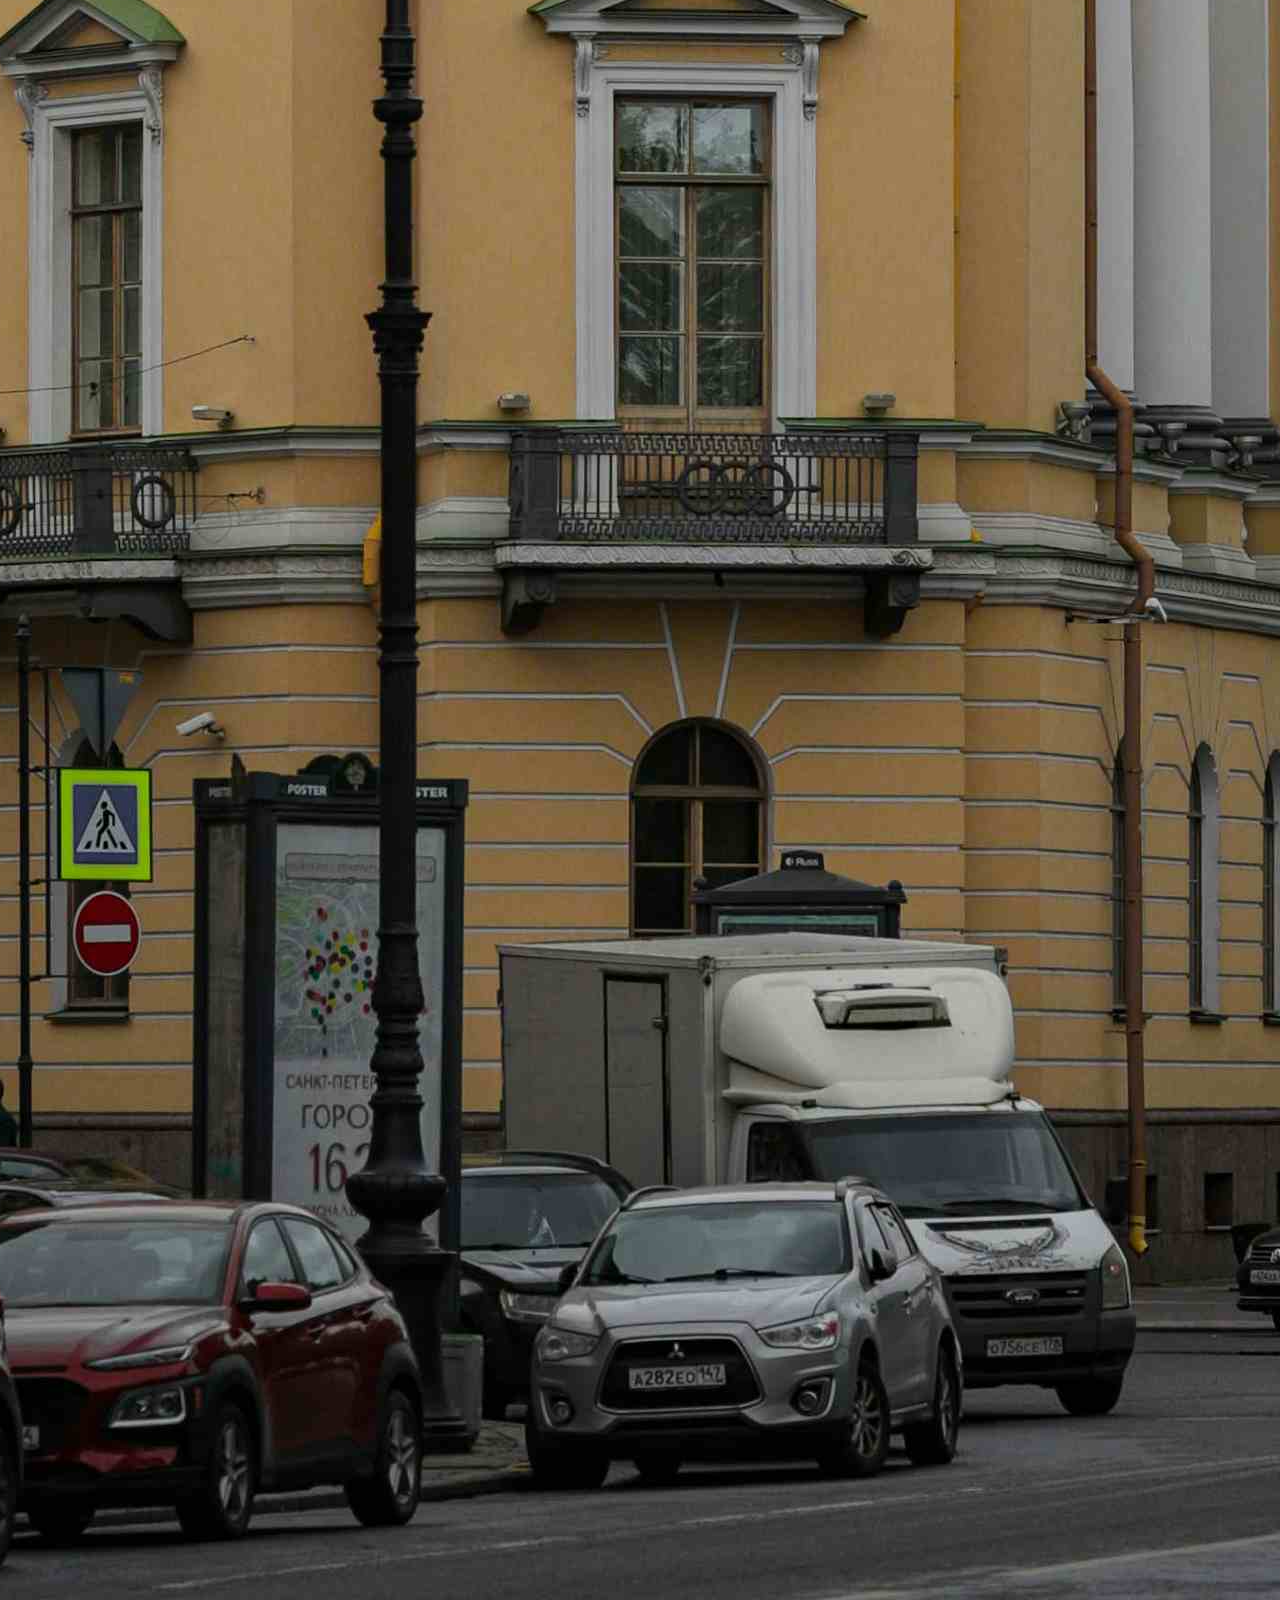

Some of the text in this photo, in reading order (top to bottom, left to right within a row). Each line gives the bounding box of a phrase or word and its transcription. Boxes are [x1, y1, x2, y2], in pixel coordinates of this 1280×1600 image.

[287, 783, 328, 798] POSTER
[416, 785, 449, 799] STER
[286, 1073, 378, 1090] САНКТ-ПЕТЕР
[302, 1103, 371, 1129] ГОРО
[634, 1369, 697, 1386] А282ЕО
